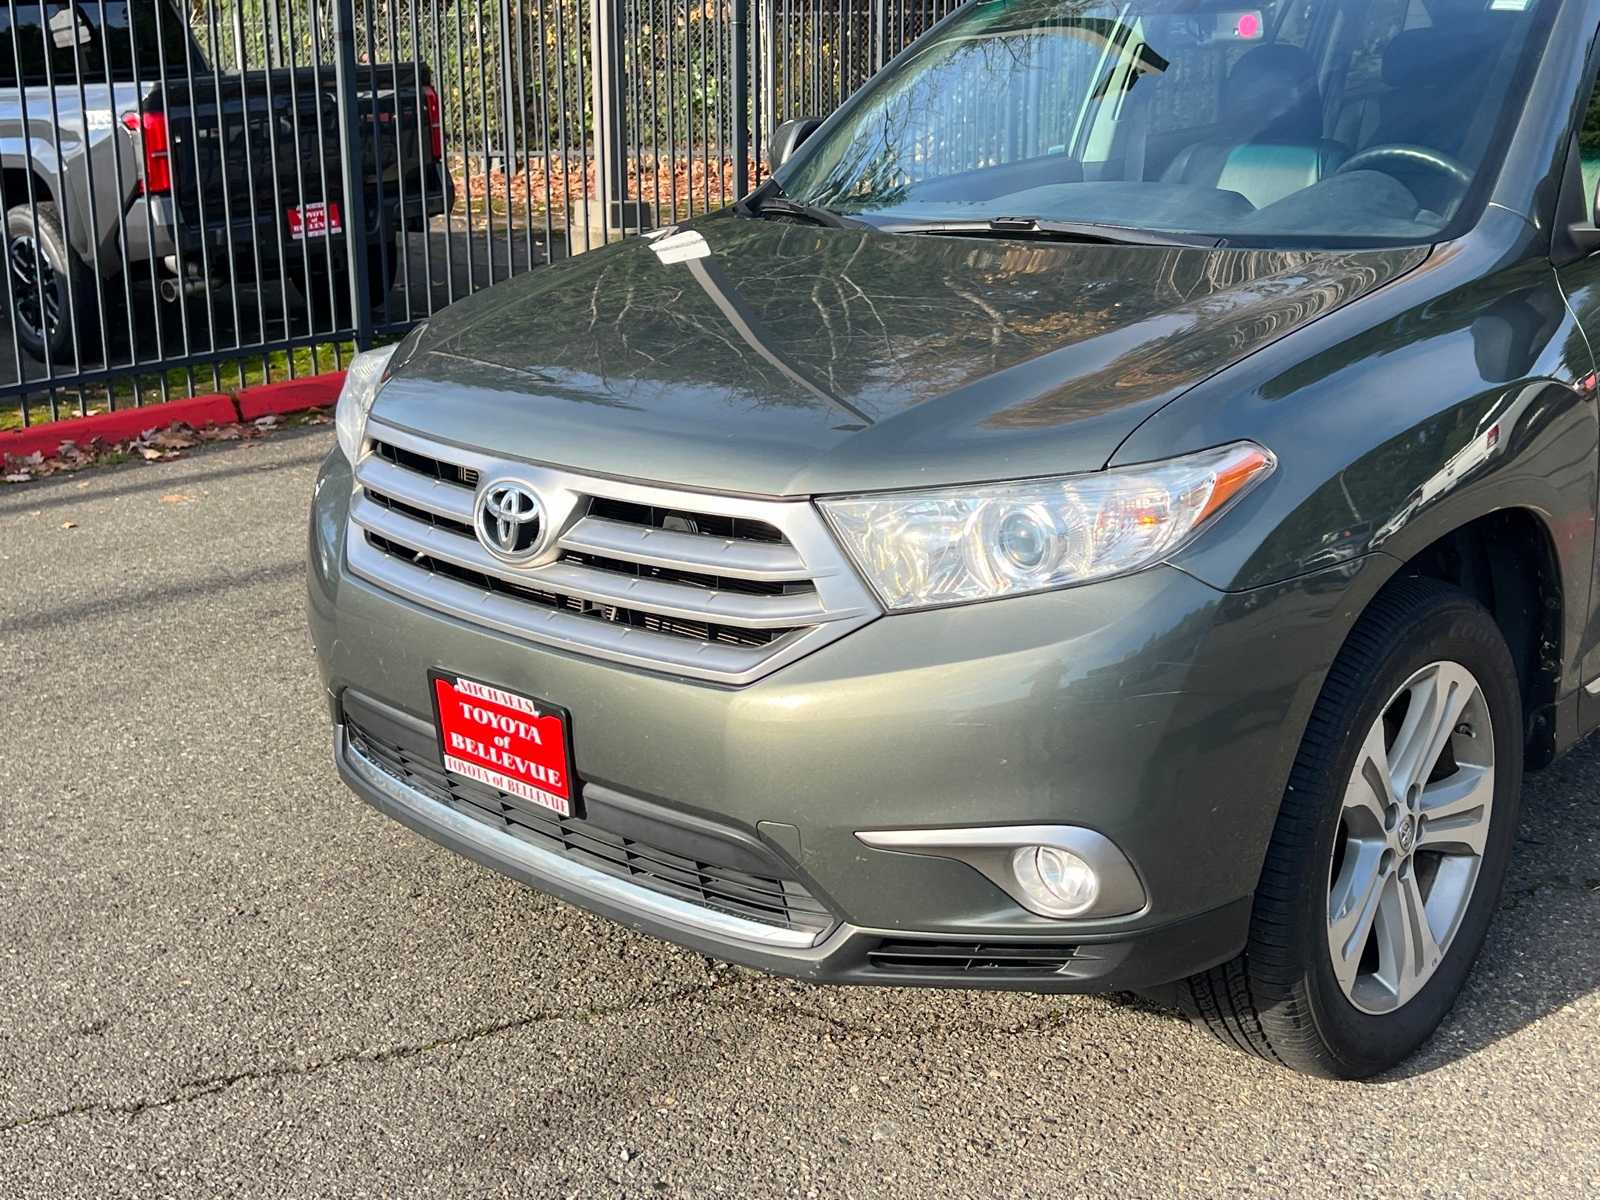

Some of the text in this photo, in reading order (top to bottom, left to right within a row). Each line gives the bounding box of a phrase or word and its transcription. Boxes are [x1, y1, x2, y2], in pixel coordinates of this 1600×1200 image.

[458, 702, 542, 745] TOYOTA
[493, 735, 511, 749] of
[450, 731, 562, 787] BELLEVUE
[446, 757, 568, 814] TOYOTA of BELLEVUE
